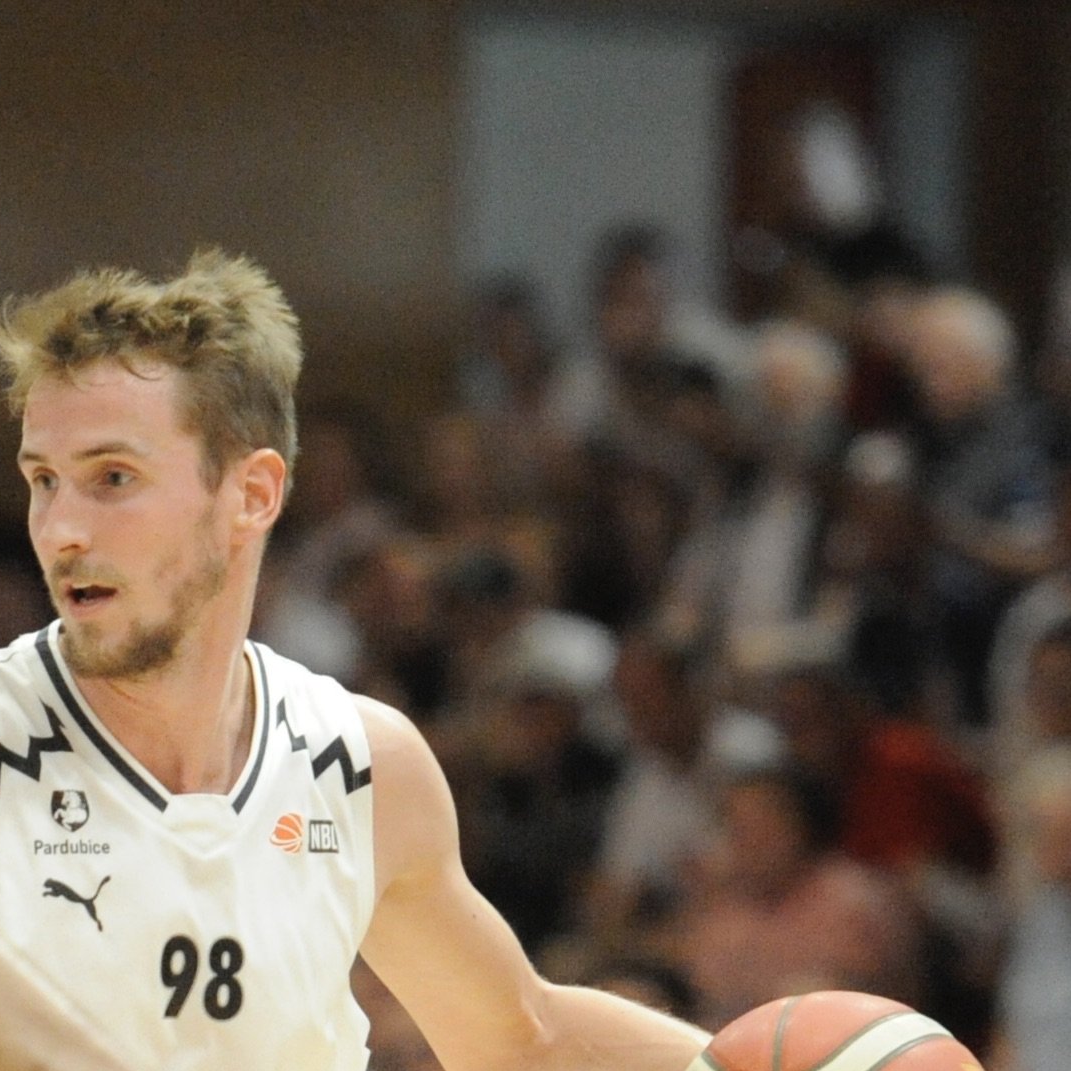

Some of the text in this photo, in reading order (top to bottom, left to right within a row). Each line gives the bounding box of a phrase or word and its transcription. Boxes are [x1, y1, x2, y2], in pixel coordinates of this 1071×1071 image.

[33, 839, 110, 855] Pardubice
[310, 822, 338, 850] NBL
[160, 934, 245, 1021] 98
